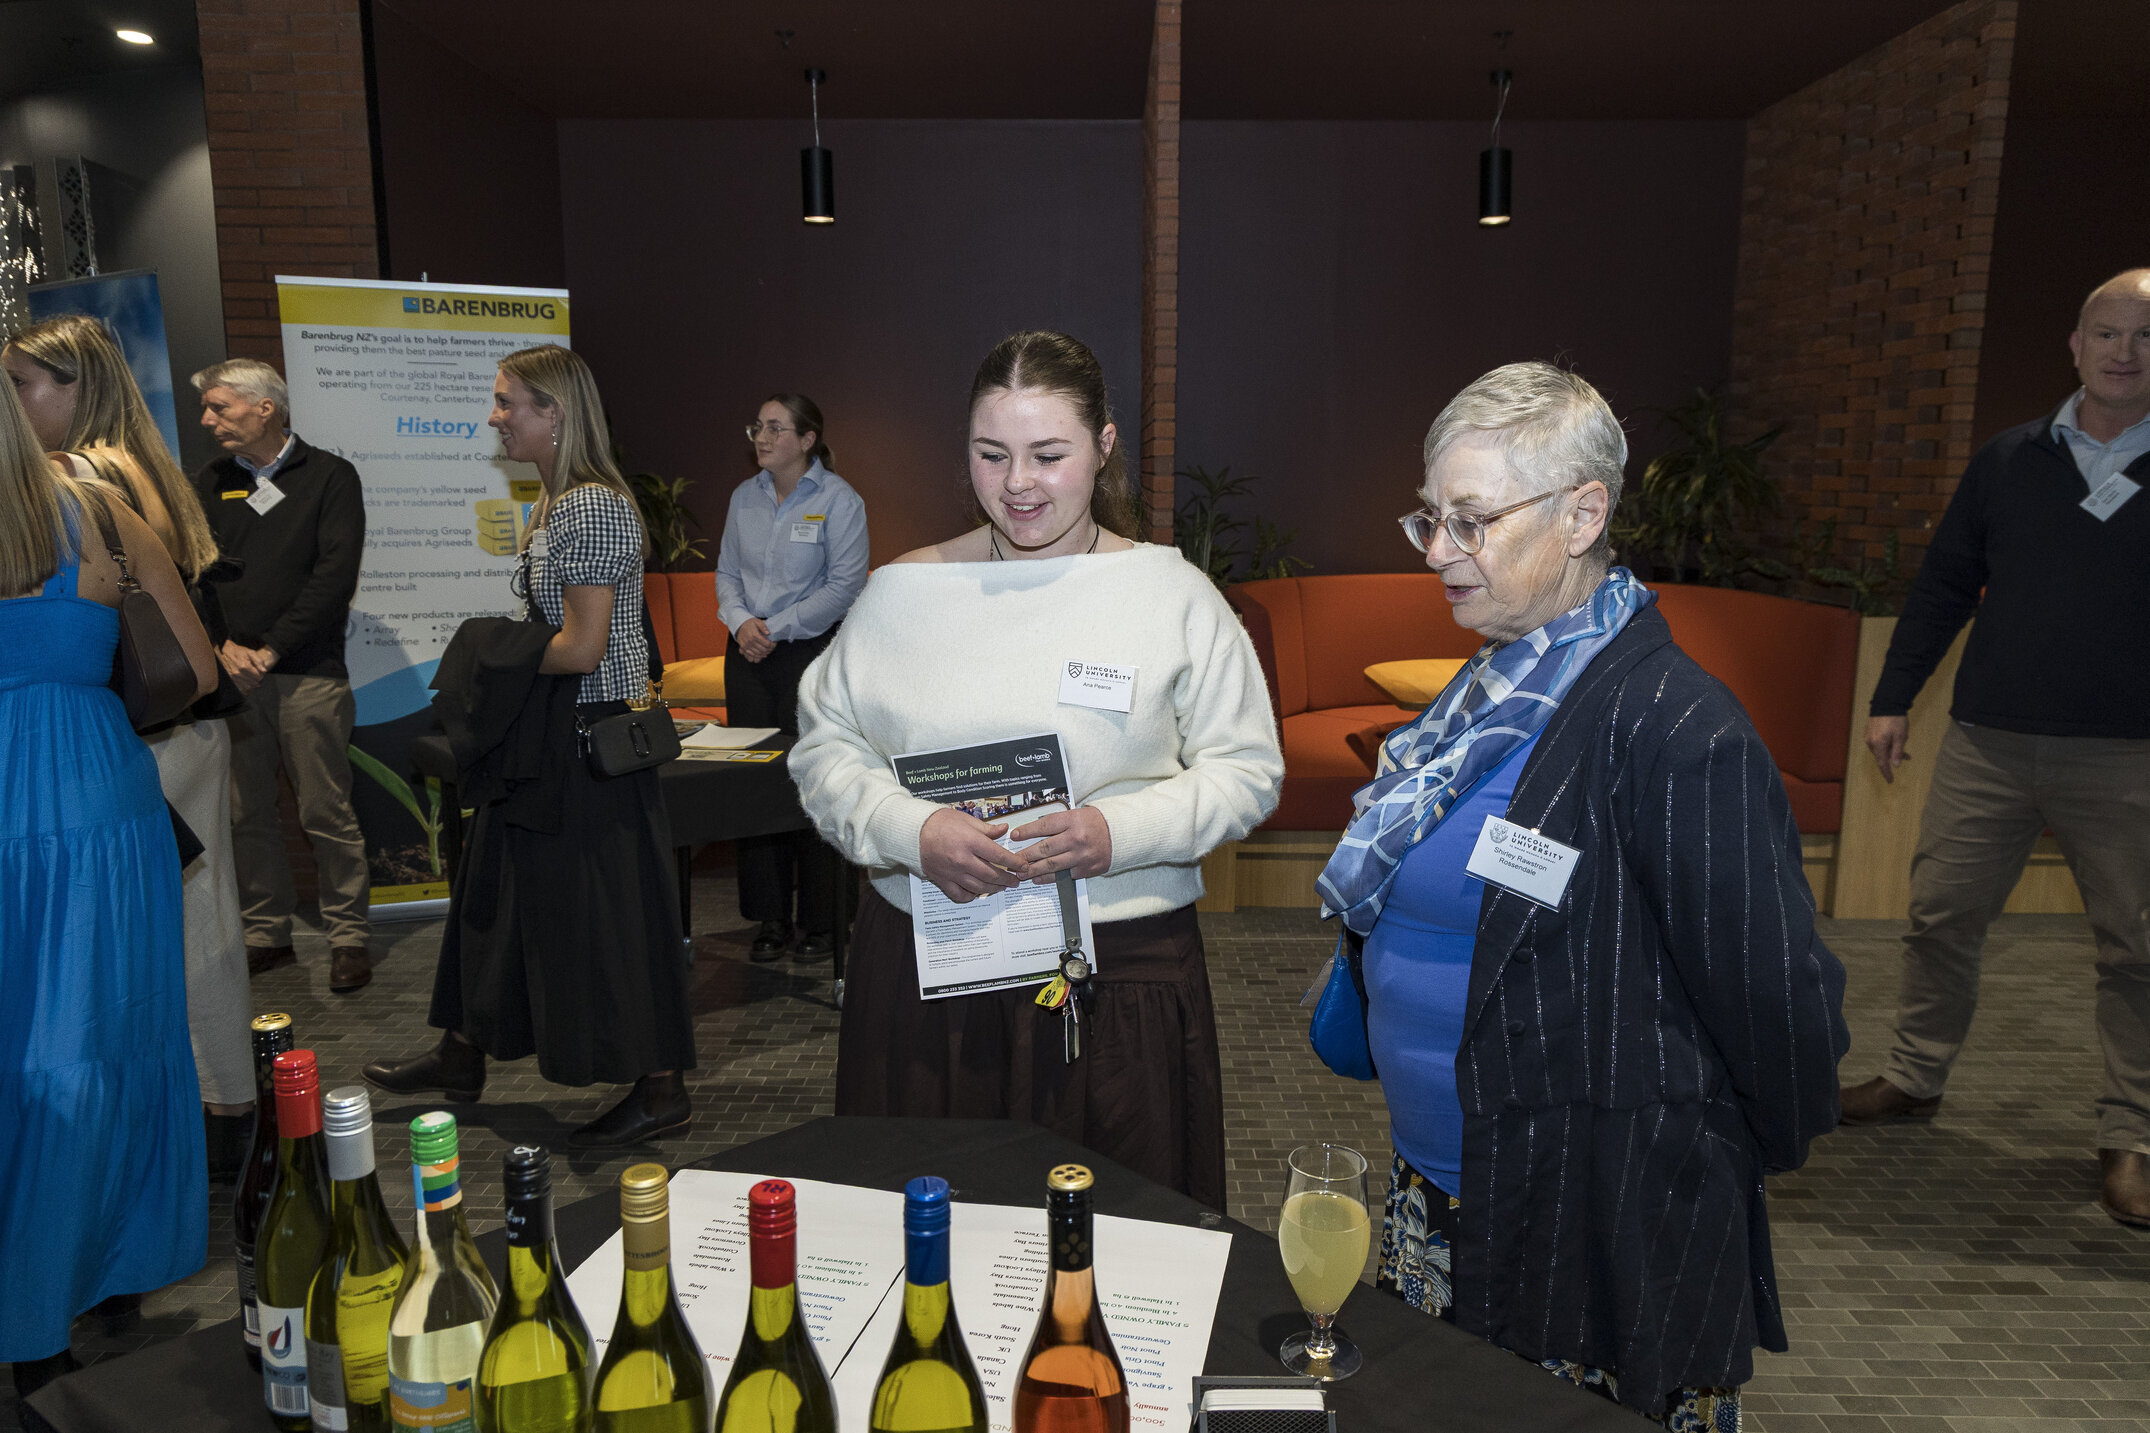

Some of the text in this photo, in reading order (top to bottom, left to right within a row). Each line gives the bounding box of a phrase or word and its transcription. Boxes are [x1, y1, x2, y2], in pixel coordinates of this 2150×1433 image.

[422, 298, 555, 320] BARENBRUG
[301, 330, 515, 347] Barenbrug NZ's goal is to help farmers thrive
[314, 344, 359, 355] providing
[362, 345, 386, 354] them
[388, 346, 404, 355] the
[406, 346, 426, 356] best
[428, 348, 462, 357] pasture
[465, 348, 486, 358] seed
[315, 367, 332, 376] We
[336, 369, 351, 377] are
[353, 369, 374, 378] part
[377, 369, 387, 377] of
[389, 370, 405, 378] the
[408, 370, 437, 381] global
[440, 371, 465, 381] Royal
[318, 381, 368, 391] operating
[370, 380, 392, 389] from
[414, 382, 432, 391] 225
[434, 383, 469, 392] hectare
[397, 416, 479, 439] History
[351, 451, 401, 462] Agriseeds
[404, 451, 460, 461] established
[463, 453, 472, 461] at
[375, 485, 428, 496] company's
[430, 485, 461, 496] yellow
[464, 485, 486, 494] seed
[403, 498, 466, 507] trademarked
[387, 527, 438, 537] Barenbrug
[441, 527, 472, 538] Group
[381, 538, 473, 549] acquires Agriseeds
[360, 568, 514, 580] Rolleston processing and distrib
[360, 582, 417, 592] centre built
[362, 611, 385, 621] Four
[389, 612, 408, 620] new
[412, 610, 455, 621] products
[457, 610, 472, 618] are
[372, 626, 399, 635] Array
[374, 637, 419, 647] Redefine
[1086, 666, 1118, 674] LINCOLN
[1086, 671, 1132, 680] UNIVERSITY
[907, 764, 1002, 784] Workshops for farming
[1513, 831, 1550, 850] LINCOLN
[1511, 837, 1564, 861] UNIVERSITY
[1493, 846, 1516, 861] Shirley
[1516, 855, 1548, 872] Rawstron
[1498, 856, 1536, 876] Rossendale
[1005, 1275, 1042, 1283] Governors
[995, 1283, 1038, 1292] Cottesbrook
[993, 1293, 1034, 1301] Rossendale
[1000, 1324, 1021, 1333] Hong
[1146, 1319, 1181, 1327] FAMILY
[969, 1331, 992, 1339] Korea
[1111, 1332, 1171, 1345] Gewurztramine
[1139, 1347, 1161, 1355] Pinot
[977, 1355, 1006, 1365] Canada
[1125, 1356, 1165, 1367] Pinot Gris
[1133, 1402, 1169, 1412] annually
